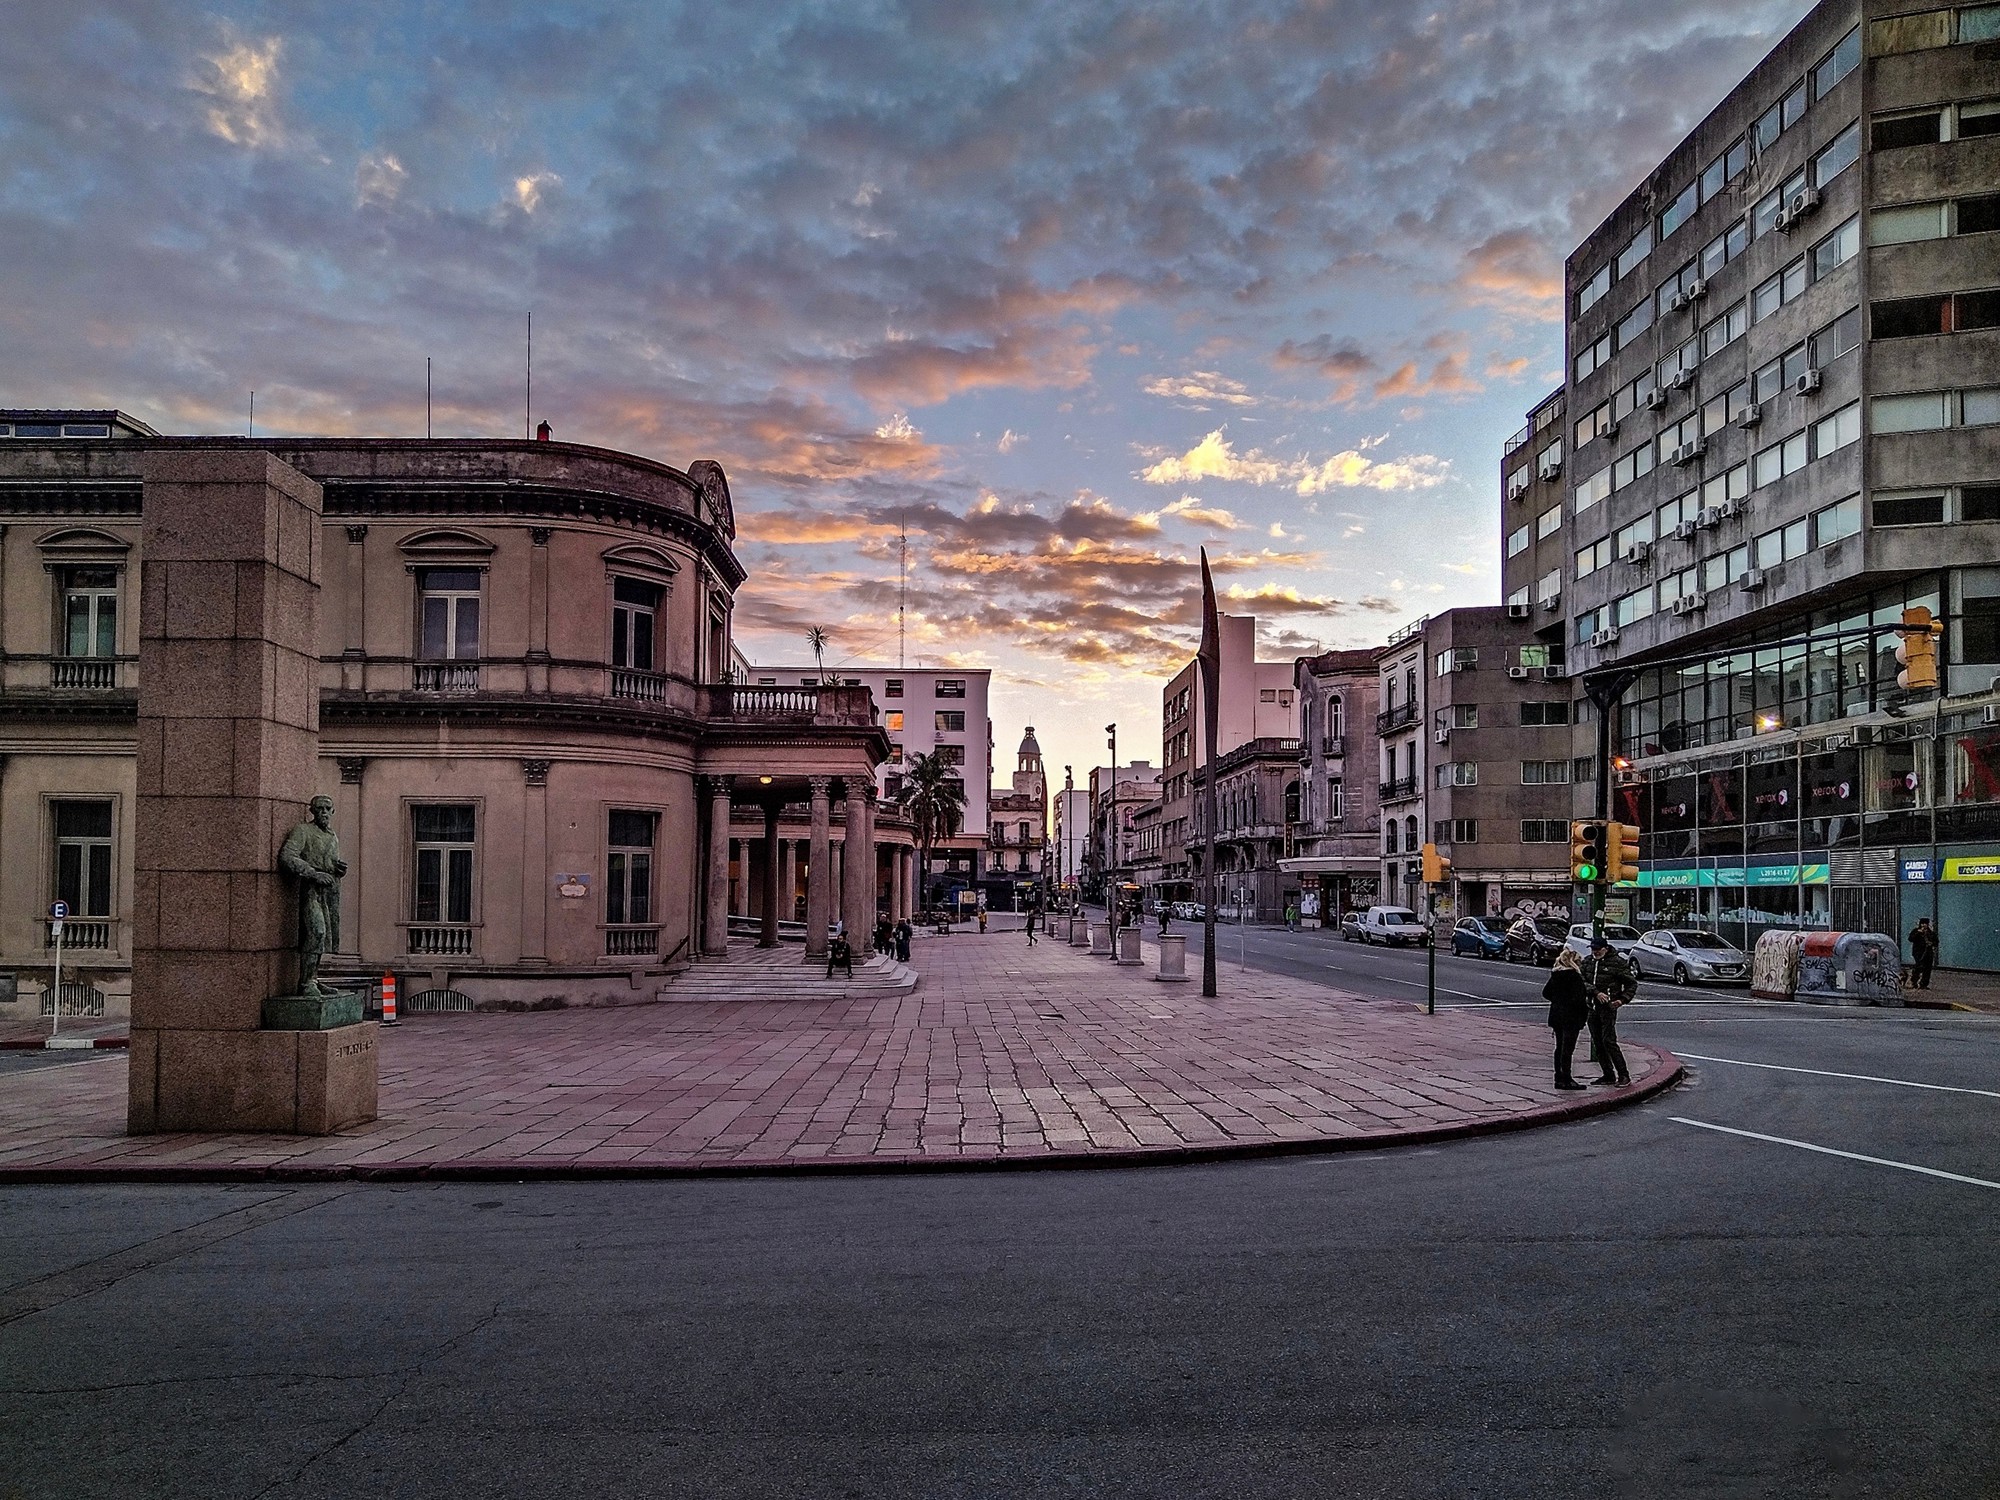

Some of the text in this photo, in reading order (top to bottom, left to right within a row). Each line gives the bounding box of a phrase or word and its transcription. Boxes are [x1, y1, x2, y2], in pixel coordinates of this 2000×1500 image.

[1812, 786, 1837, 797] xerox
[1755, 793, 1777, 804] xerox
[1962, 865, 1997, 876] redpagos
[55, 903, 64, 917] E
